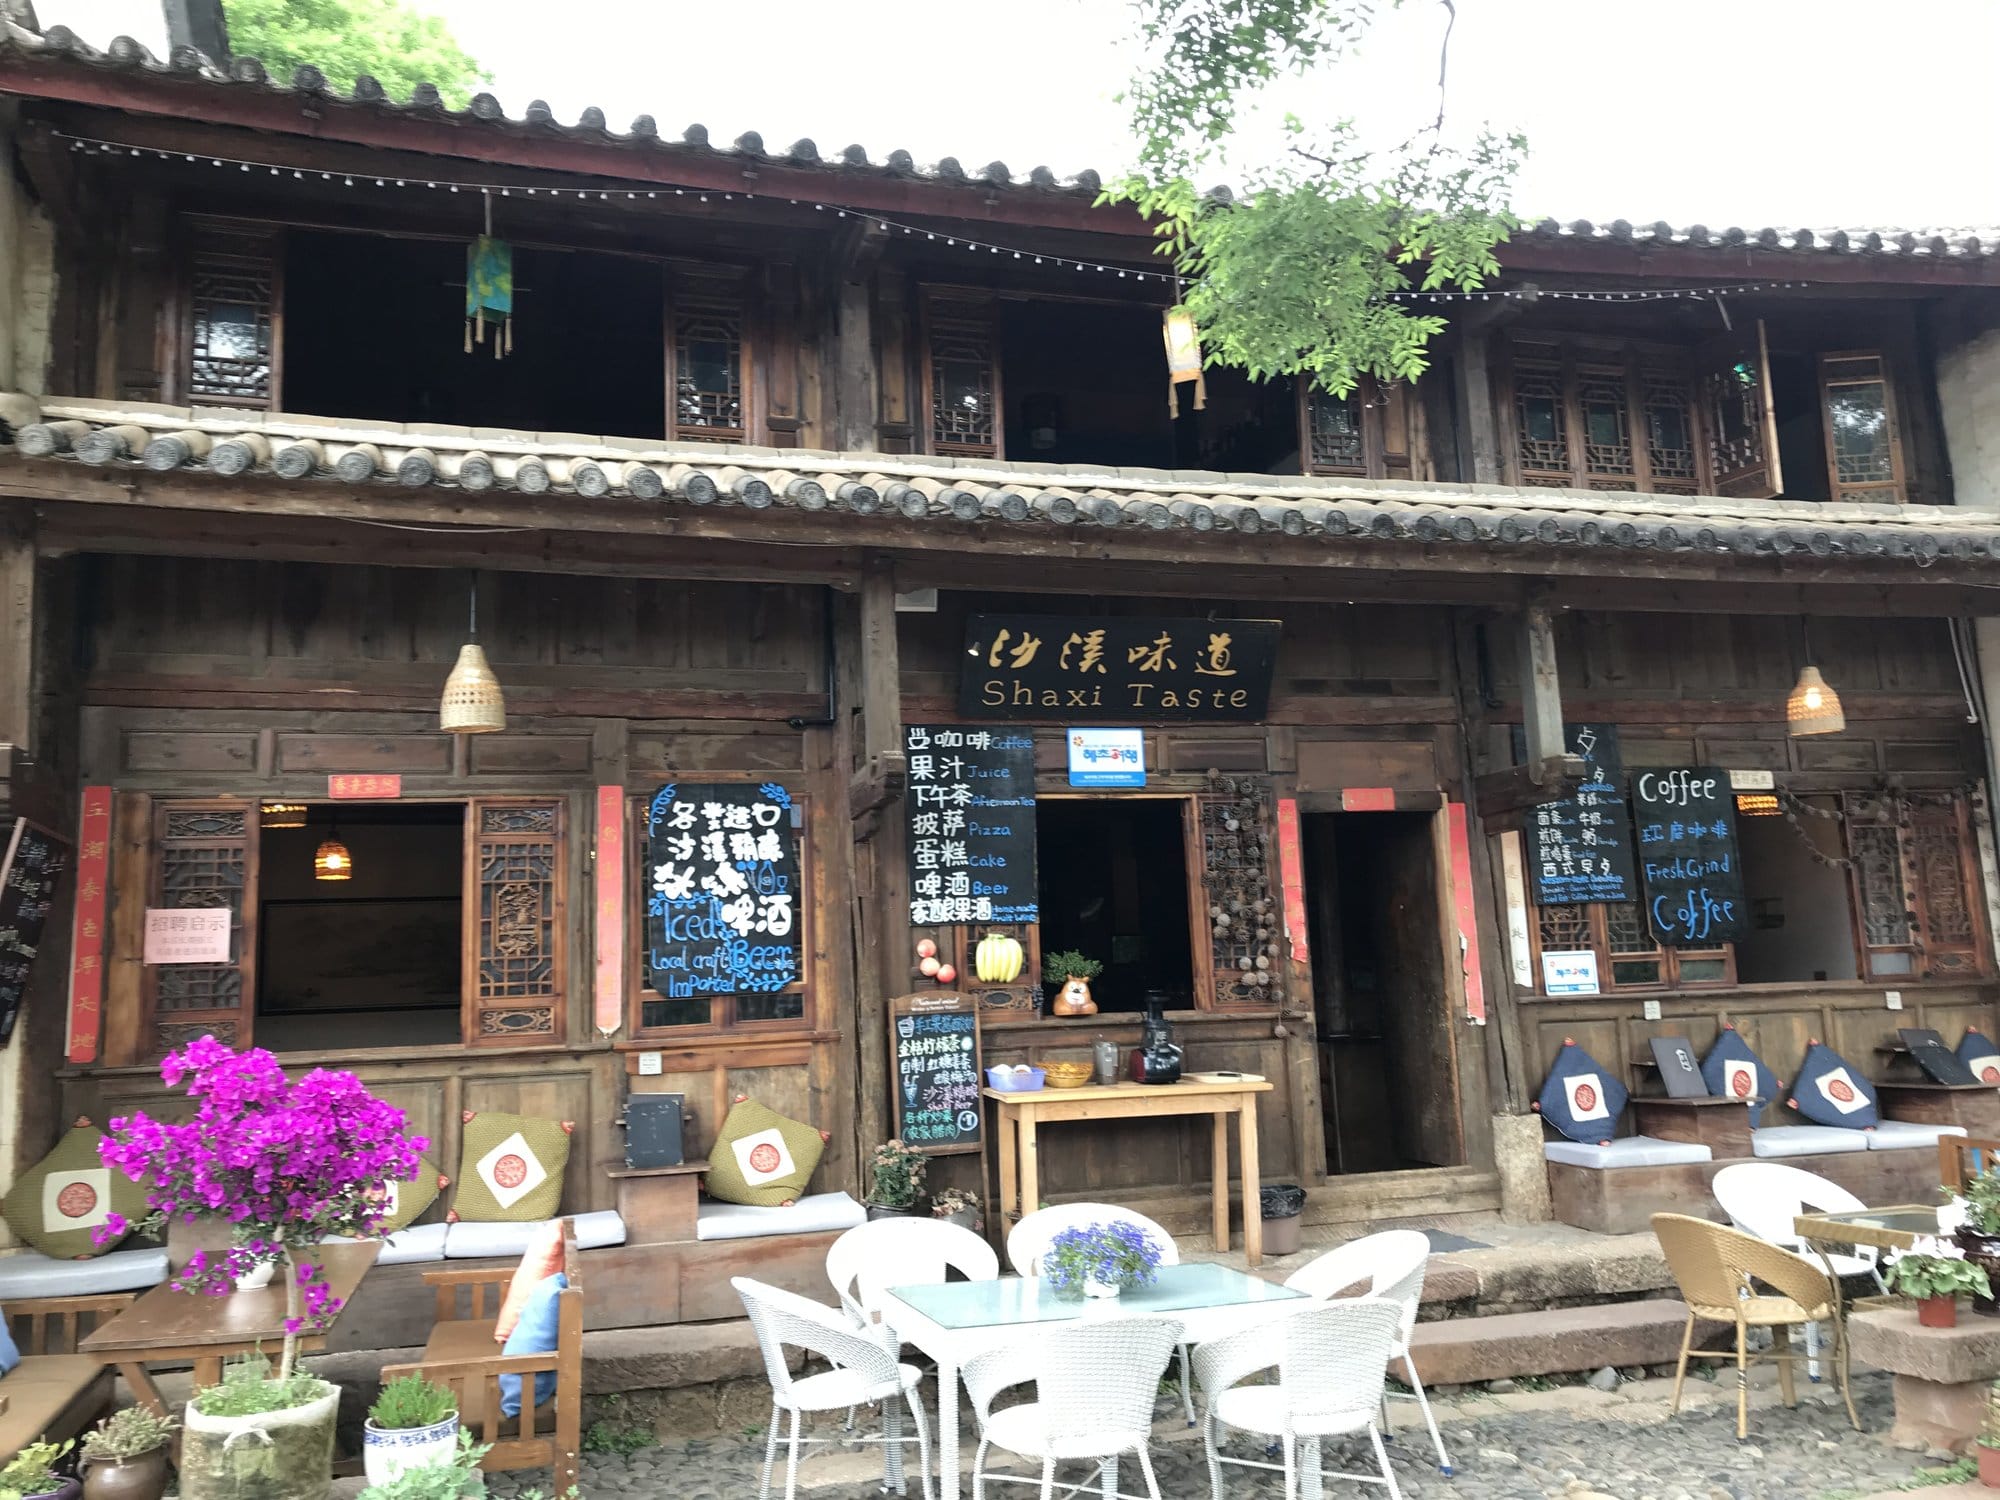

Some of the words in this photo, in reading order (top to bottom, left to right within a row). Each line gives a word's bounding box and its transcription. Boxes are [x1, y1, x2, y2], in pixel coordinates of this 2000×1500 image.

[988, 628, 1238, 677] 沙溪味道
[981, 680, 1102, 707] Shaxi
[1127, 683, 1248, 708] Taste
[934, 730, 991, 750] 咖啡
[991, 736, 1033, 750] Coffee
[909, 755, 965, 780] 果汁
[968, 765, 1010, 778] Juice
[910, 783, 973, 809] 下午茶
[1639, 769, 1716, 806] Coffee
[912, 808, 966, 837] 披萨
[968, 821, 1012, 836] Pizza
[913, 838, 969, 870] 蛋糕
[969, 853, 1007, 868] Cake
[915, 870, 969, 898] 啤酒
[972, 880, 1009, 895] Beer
[664, 897, 718, 943] Iced
[721, 893, 793, 937] 啤酒
[909, 896, 991, 924] 家酿果酒
[1653, 887, 1734, 939] Coffee
[651, 946, 691, 972] Local
[731, 940, 793, 970] Beer
